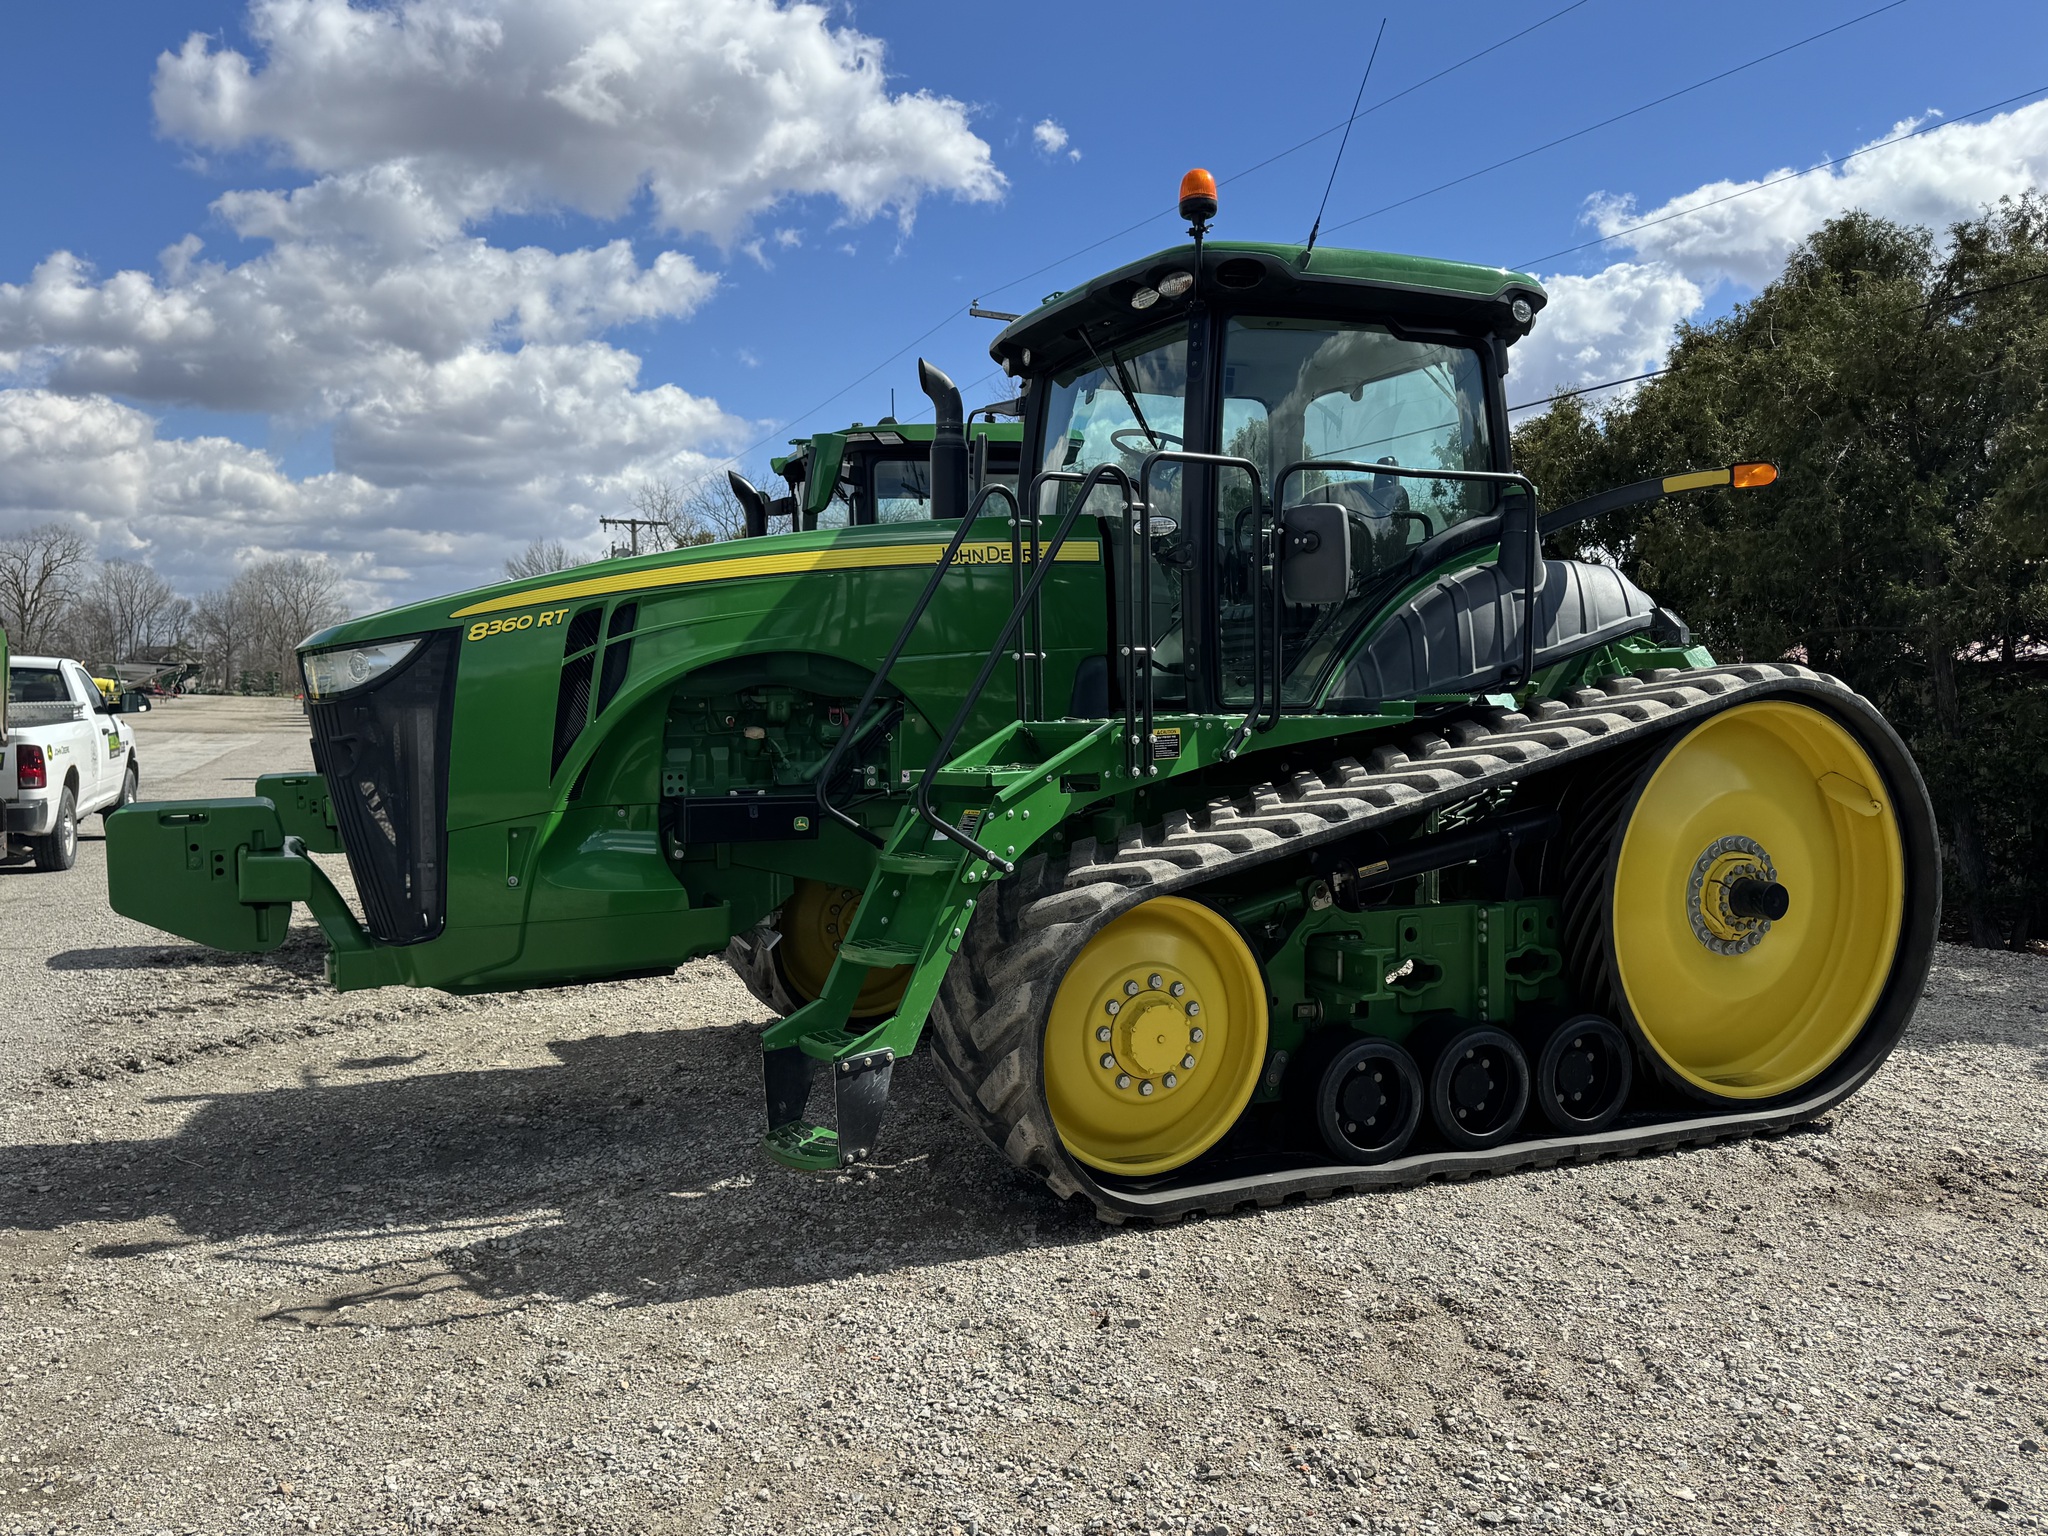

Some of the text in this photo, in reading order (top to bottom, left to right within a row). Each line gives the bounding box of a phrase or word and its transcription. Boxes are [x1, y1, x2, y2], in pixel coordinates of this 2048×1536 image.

[986, 546, 1043, 561] DER
[467, 608, 570, 641] 8360 RT
